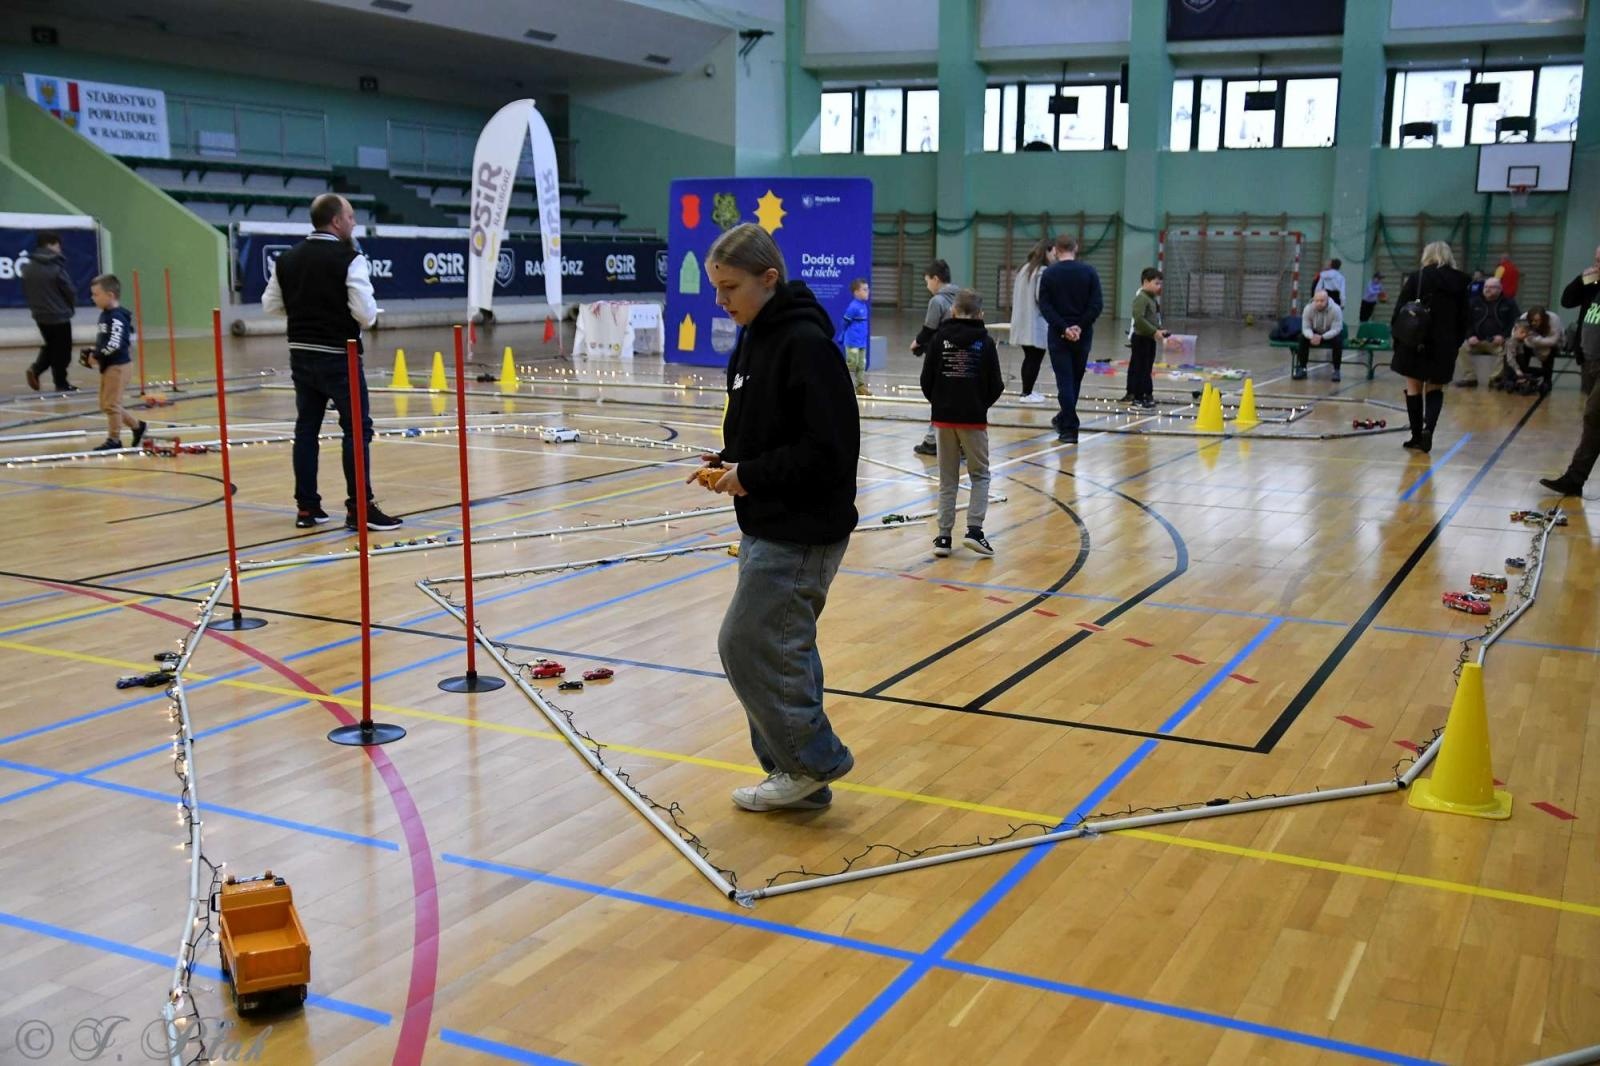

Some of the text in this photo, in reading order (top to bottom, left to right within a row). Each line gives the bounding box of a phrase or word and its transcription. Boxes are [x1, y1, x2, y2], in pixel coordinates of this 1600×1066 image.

[86, 90, 157, 108] STAROSTWO
[87, 107, 157, 125] POWIATOWE
[423, 252, 465, 276] OSiR
[605, 254, 636, 274] OSiR
[802, 253, 855, 267] Dodaj coś
[814, 266, 841, 278] siebie
